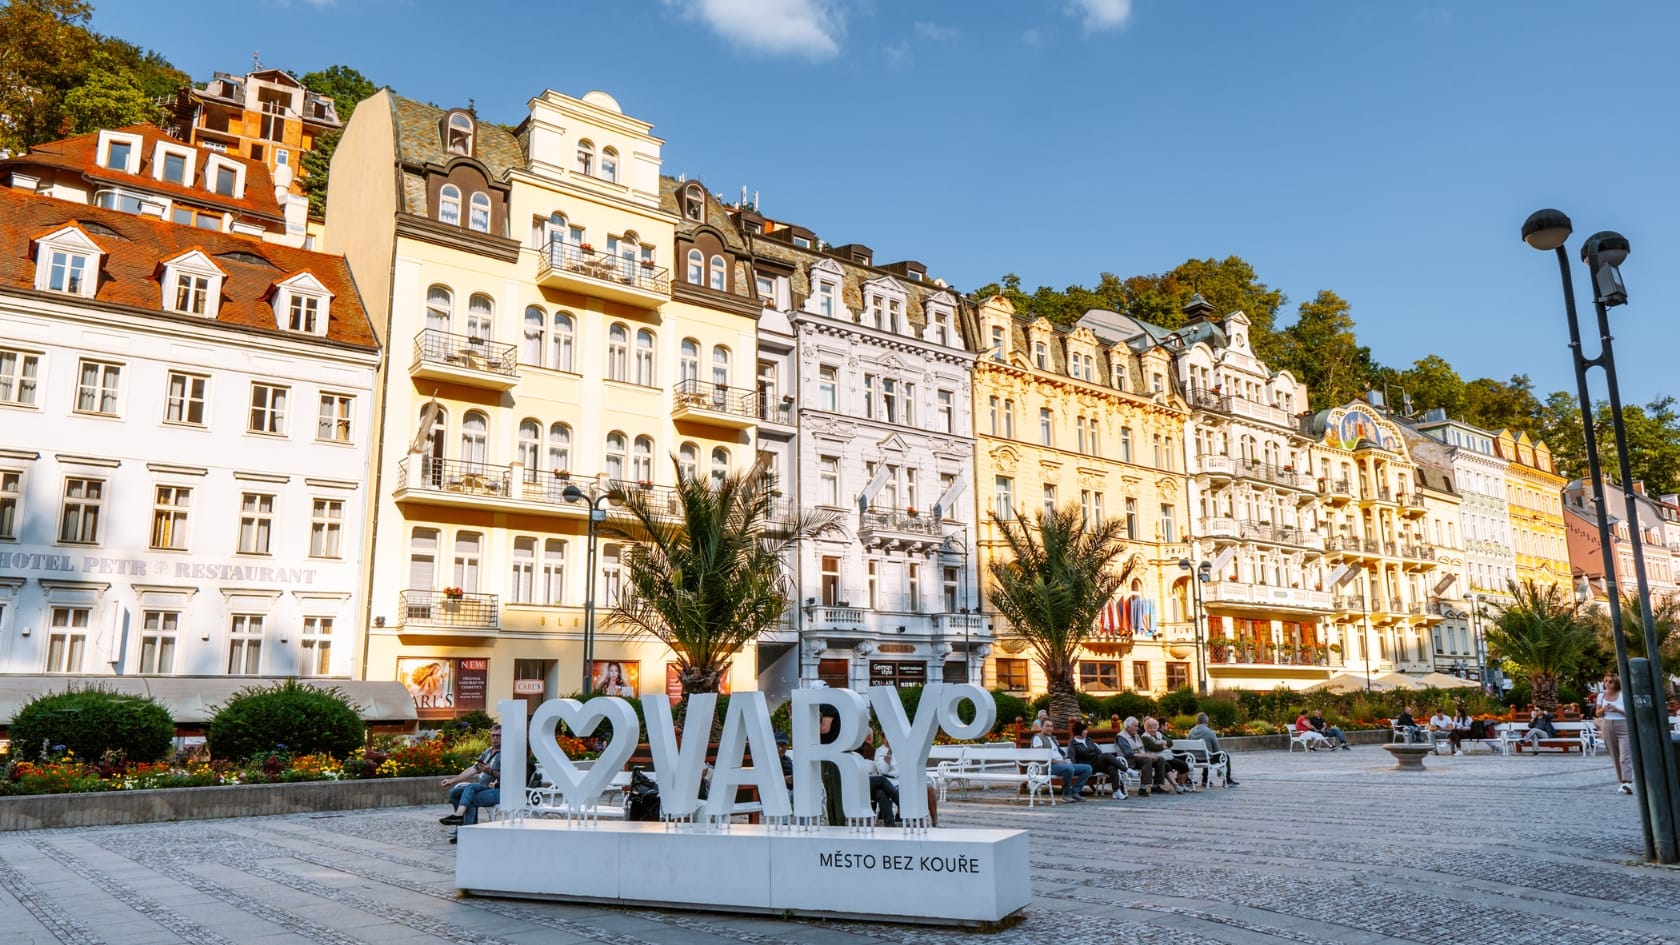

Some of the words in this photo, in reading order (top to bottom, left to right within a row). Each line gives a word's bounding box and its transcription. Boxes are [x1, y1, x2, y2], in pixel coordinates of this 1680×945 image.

[0, 552, 74, 572] HOTEL
[81, 557, 147, 576] PETR
[174, 562, 317, 584] RESTAURANT
[461, 660, 484, 669] NEW
[412, 694, 453, 709] ARL'S
[497, 700, 527, 812] I
[820, 850, 876, 869] MĚSTO
[882, 855, 914, 871] BEZ
[920, 854, 979, 873] KOUŘE
